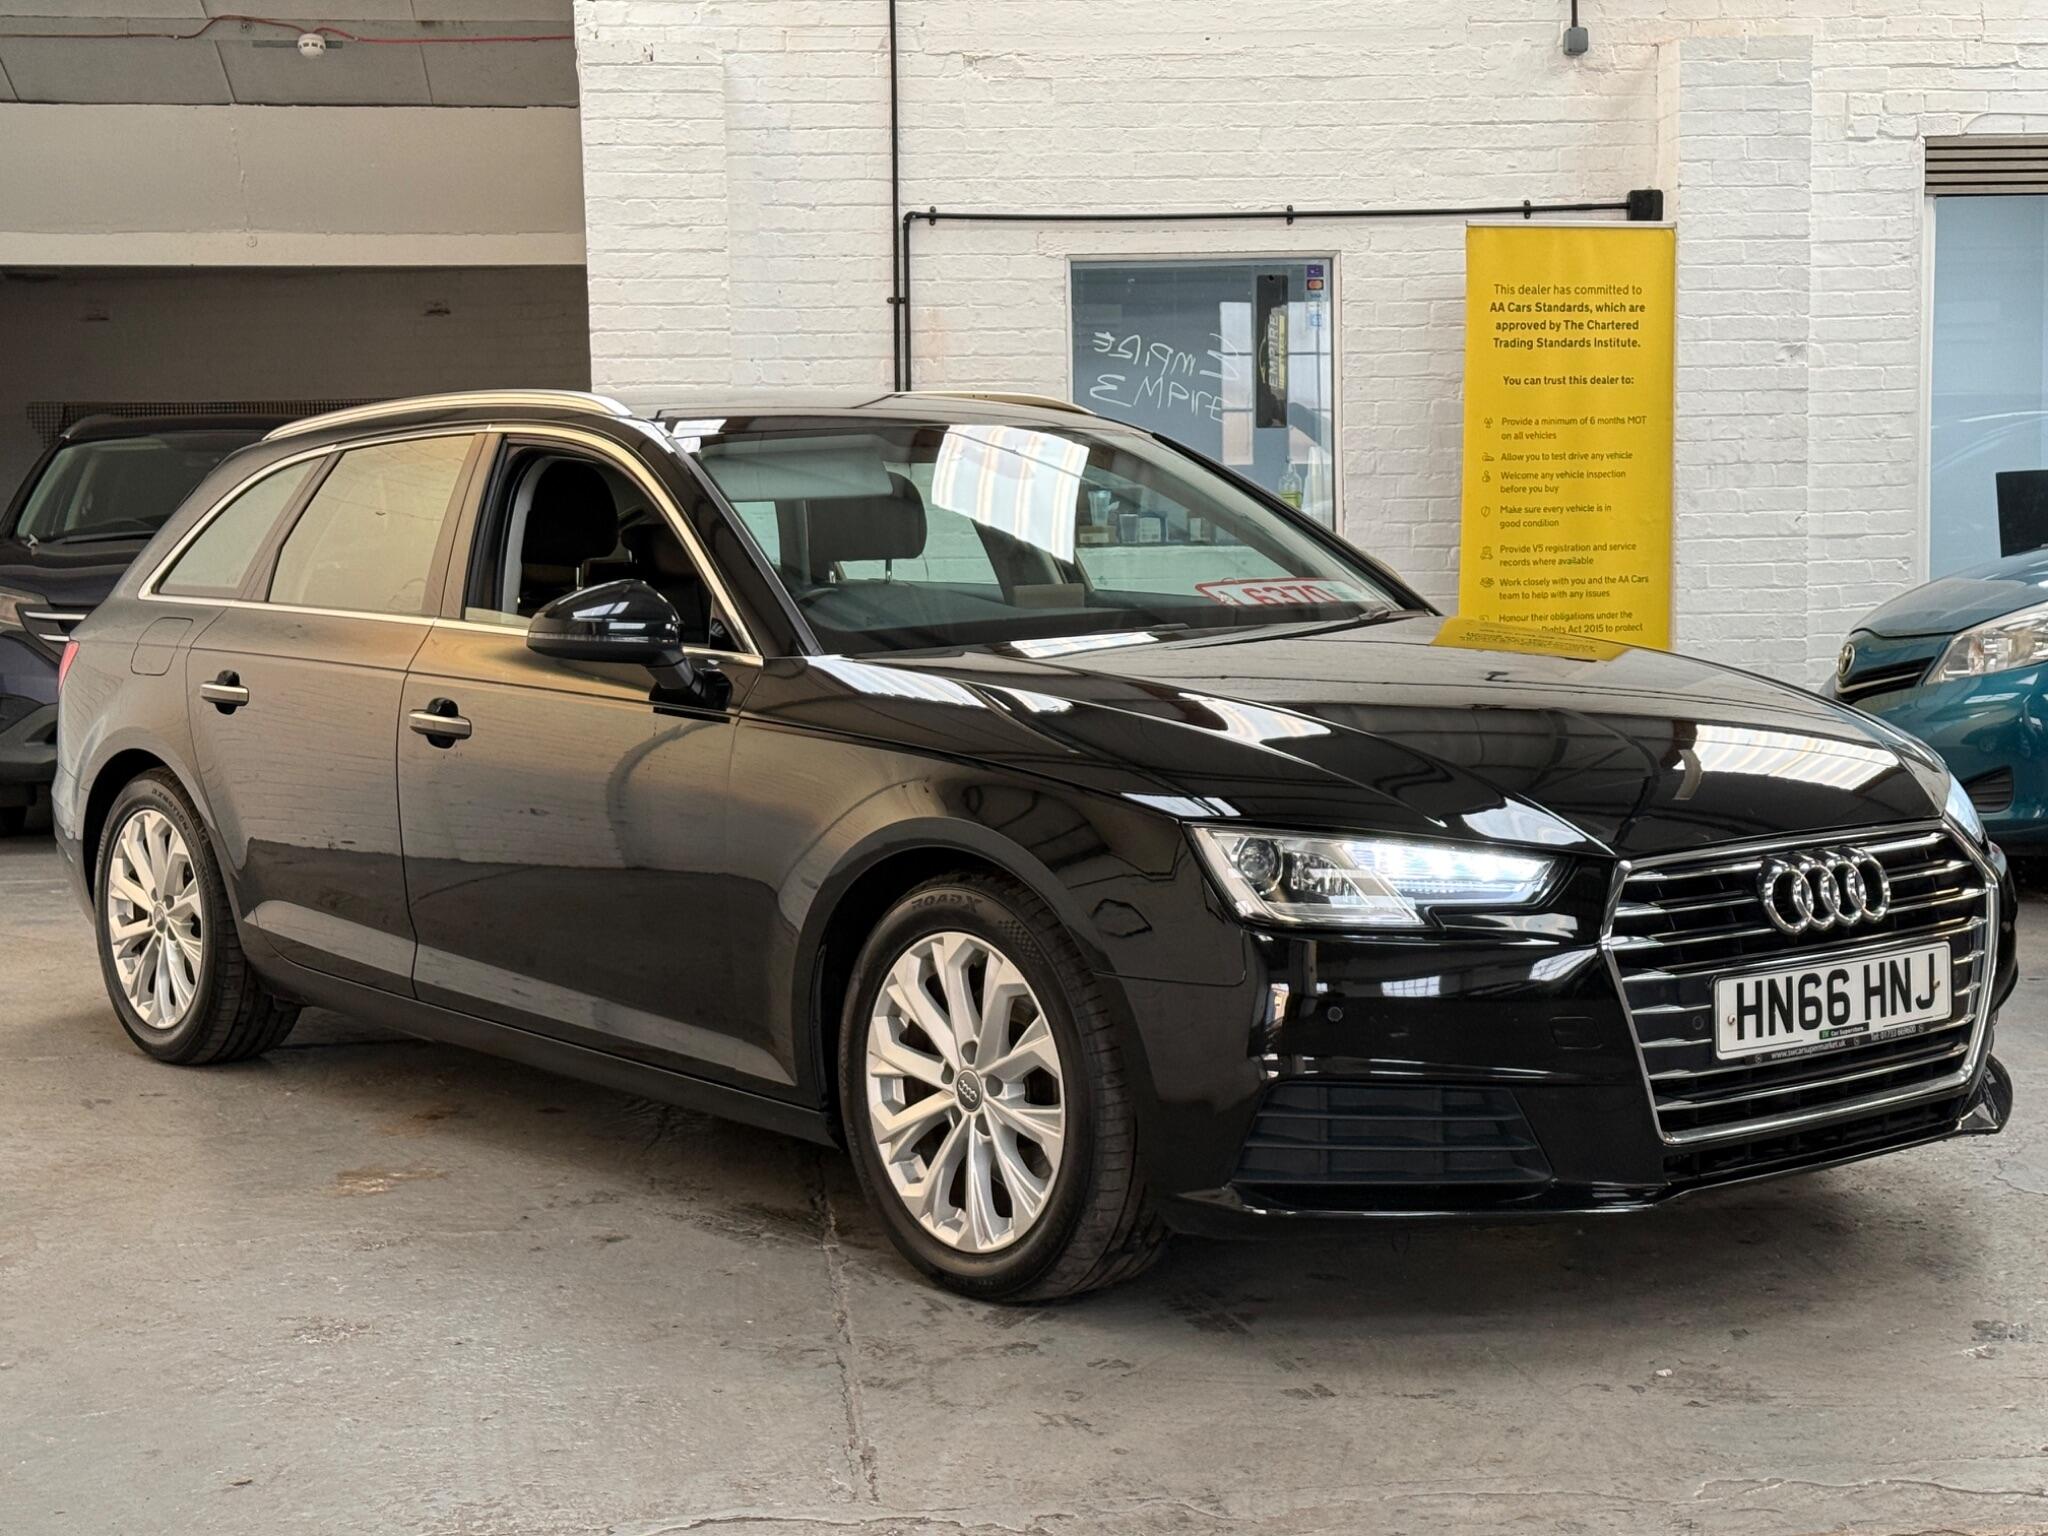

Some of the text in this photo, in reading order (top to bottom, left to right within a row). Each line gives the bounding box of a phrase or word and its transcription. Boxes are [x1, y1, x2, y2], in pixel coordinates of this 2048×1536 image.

[1494, 283, 1642, 296] This dealer has committed to
[1489, 301, 1645, 314] AA Cars Standards, which are
[1495, 319, 1639, 332] approved by The Chartered
[1493, 336, 1641, 350] Trading Standards Institute.
[1267, 315, 1279, 387] EMPIRE
[1503, 374, 1634, 386] You can trust this dealer to:
[1502, 415, 1648, 426] Provide a minimum of 6 months MOT
[1501, 430, 1557, 441] on all vehicles
[1500, 450, 1633, 462] Allow you to test drive any vehicle
[1500, 469, 1626, 481] Welcome any vehicle inspection
[1500, 484, 1560, 495] before you buy
[1499, 503, 1612, 515] Make sure every vehicle is in
[1499, 519, 1559, 530] good condition
[1500, 542, 1637, 554] Provide V5 registration and service
[1499, 556, 1594, 567] records where available
[1500, 574, 1648, 588] Work closely with you and the AA Cars
[1499, 589, 1610, 600] team to help with any issues
[1499, 610, 1633, 623] Honour their obligations under the
[1567, 624, 1582, 634] Act
[1583, 623, 1604, 633] 2015
[1605, 623, 1613, 633] to
[1614, 622, 1643, 632] protect
[1736, 953, 1935, 1041] HN66 HNJ
